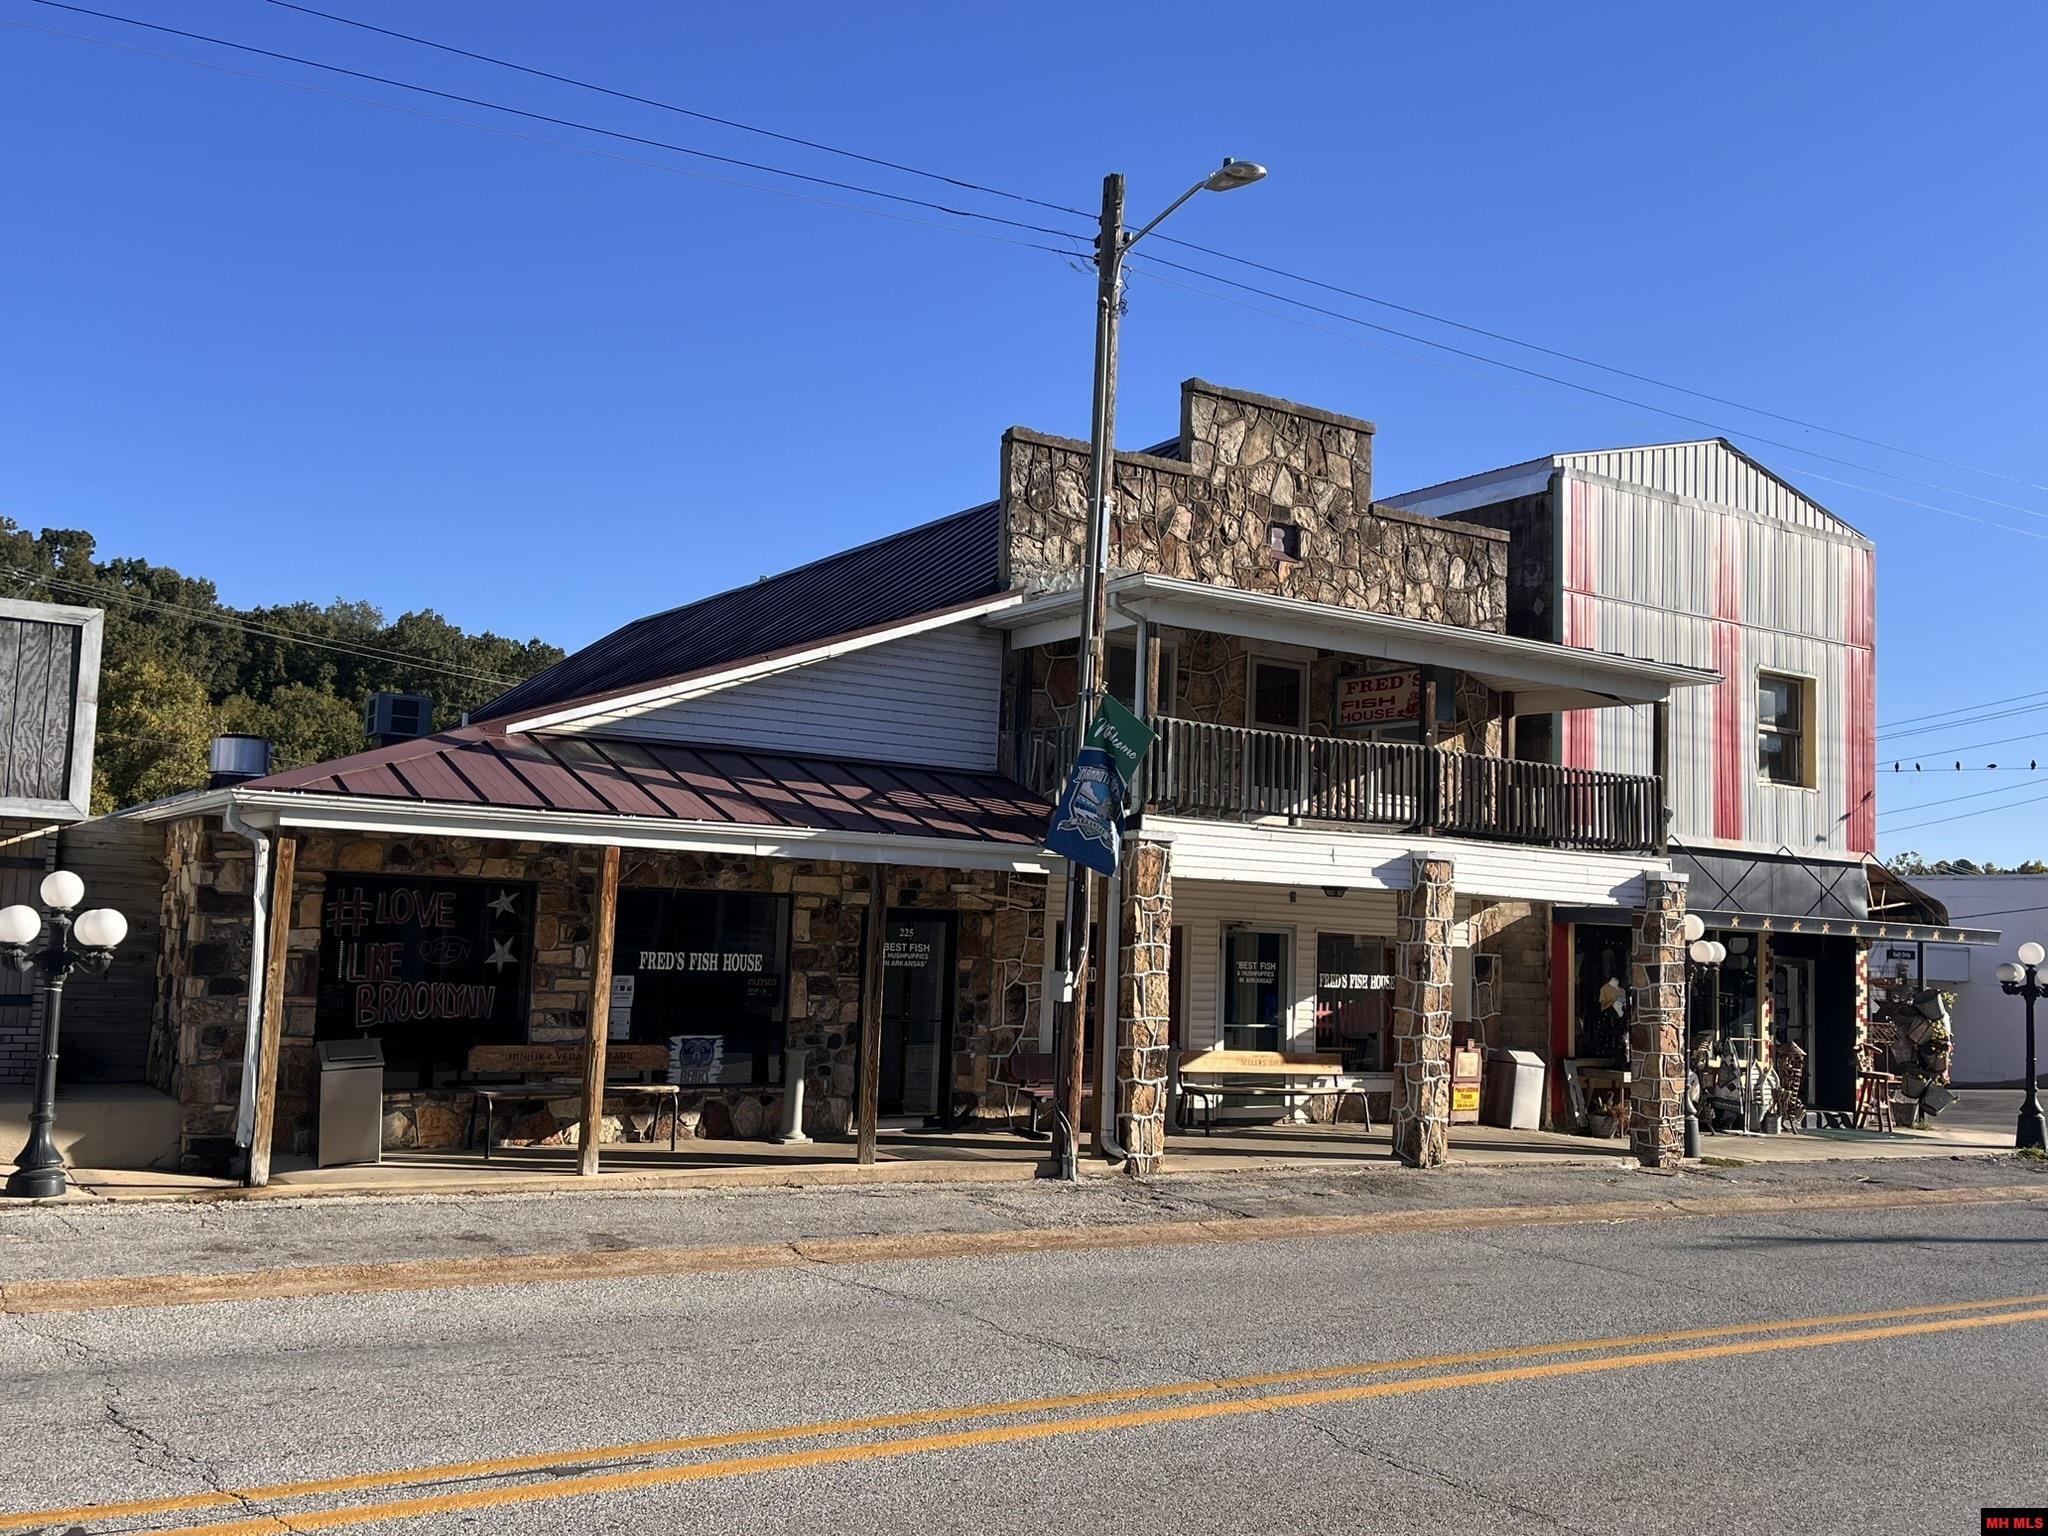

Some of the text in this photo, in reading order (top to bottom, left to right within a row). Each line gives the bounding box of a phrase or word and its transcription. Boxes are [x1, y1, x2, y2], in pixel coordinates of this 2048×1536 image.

[1345, 673, 1421, 695] FRED'S
[1341, 696, 1395, 711] FISH
[1341, 708, 1395, 722] HOUSE
[1094, 717, 1137, 759] Welcome
[899, 928, 914, 937] 225
[419, 940, 472, 961] OPEN
[909, 944, 931, 952] FISH
[346, 943, 404, 984] LIKE
[639, 951, 764, 973] FRED'S FISH HOUSE
[1259, 962, 1276, 971] FISH
[747, 978, 777, 987] CLOSED
[1319, 973, 1395, 990] FRED'S FISH HOUSE
